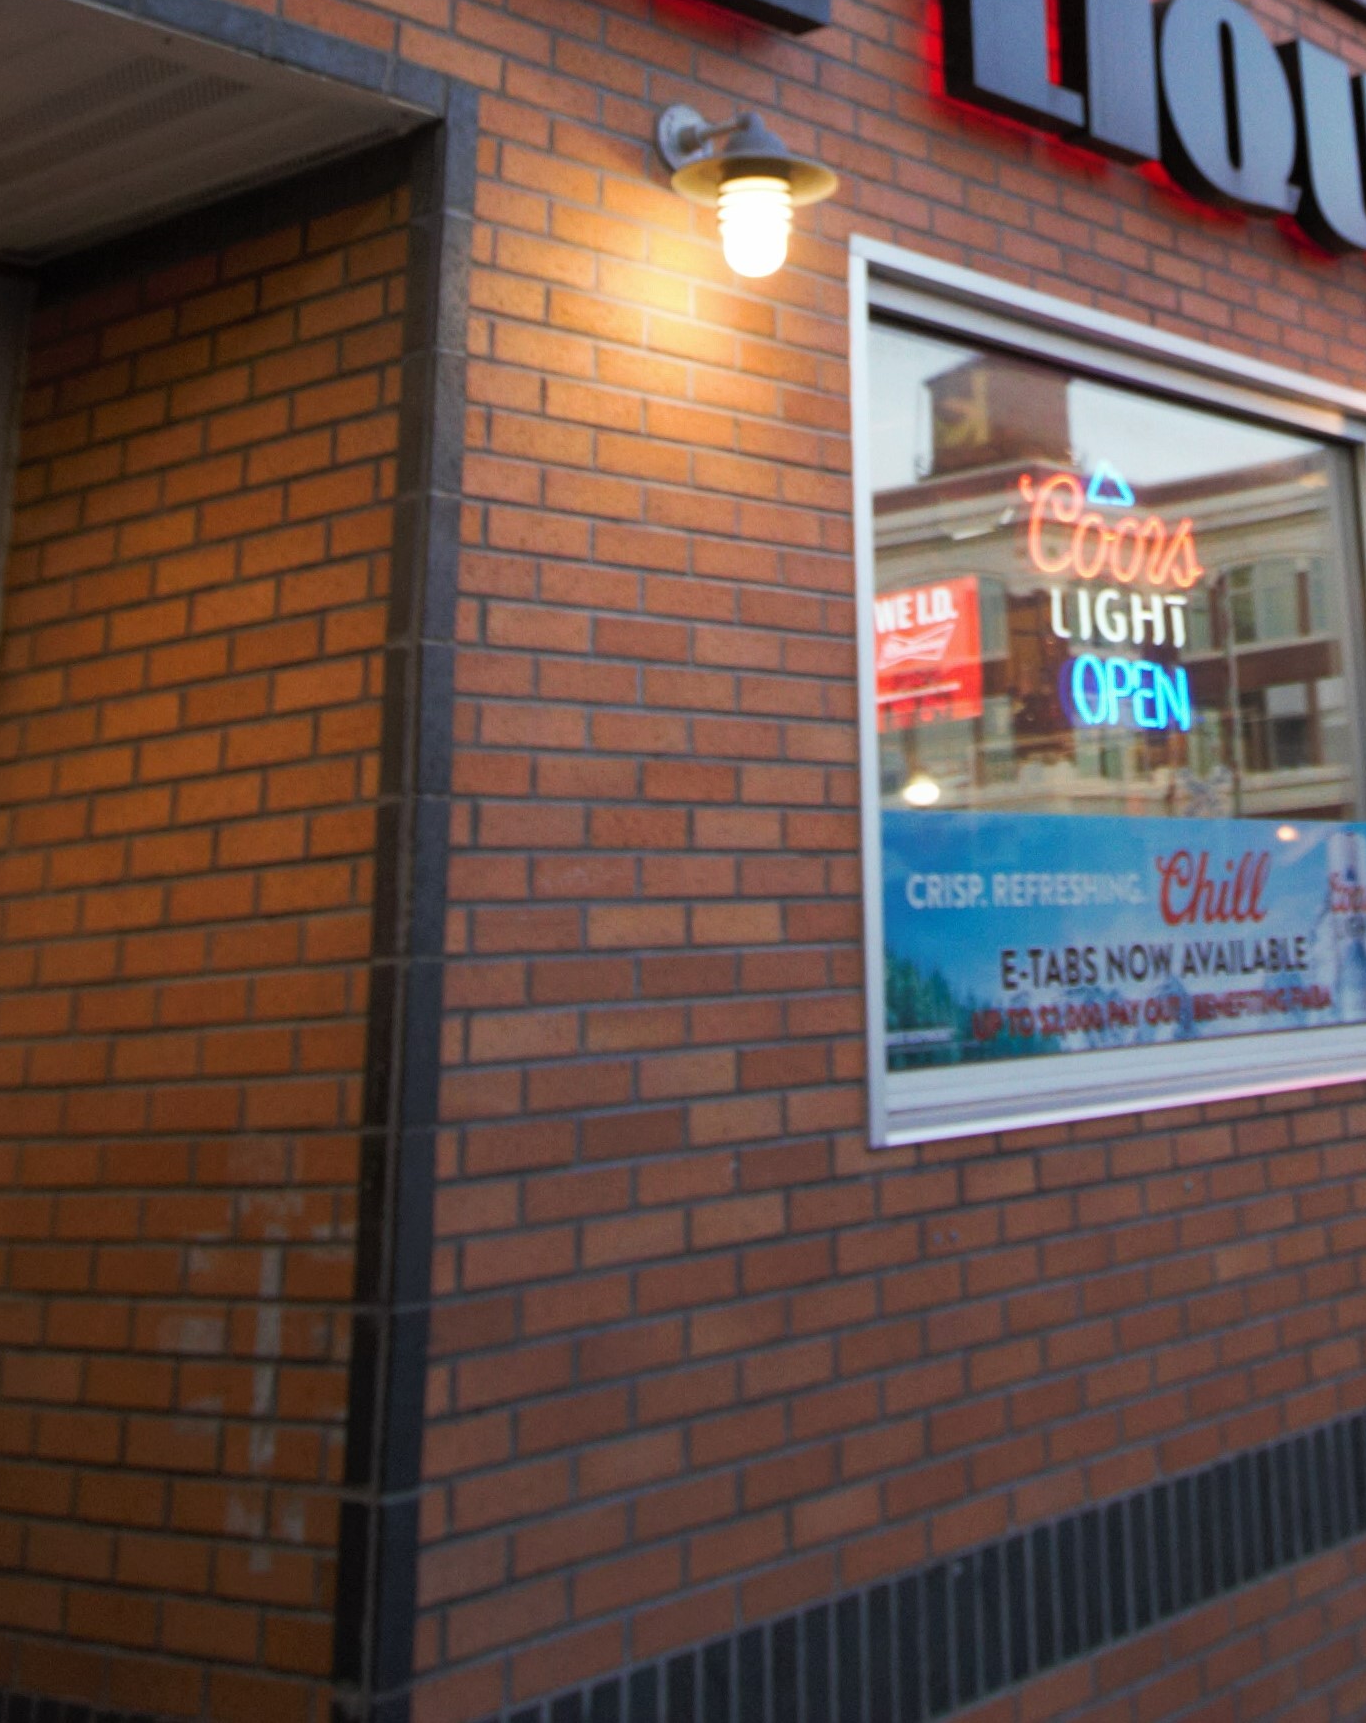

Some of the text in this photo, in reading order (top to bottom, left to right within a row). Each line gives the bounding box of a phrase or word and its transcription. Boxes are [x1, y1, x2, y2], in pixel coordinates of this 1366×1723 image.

[1018, 473, 1204, 588] Coors
[873, 593, 914, 634] WE
[1050, 586, 1190, 649] LIGHT
[1070, 653, 1192, 733] OPEN
[905, 872, 989, 910] CRISP.
[1155, 848, 1271, 927] Chill
[1000, 936, 1309, 991] E-TABS NOW AVAILABLE
